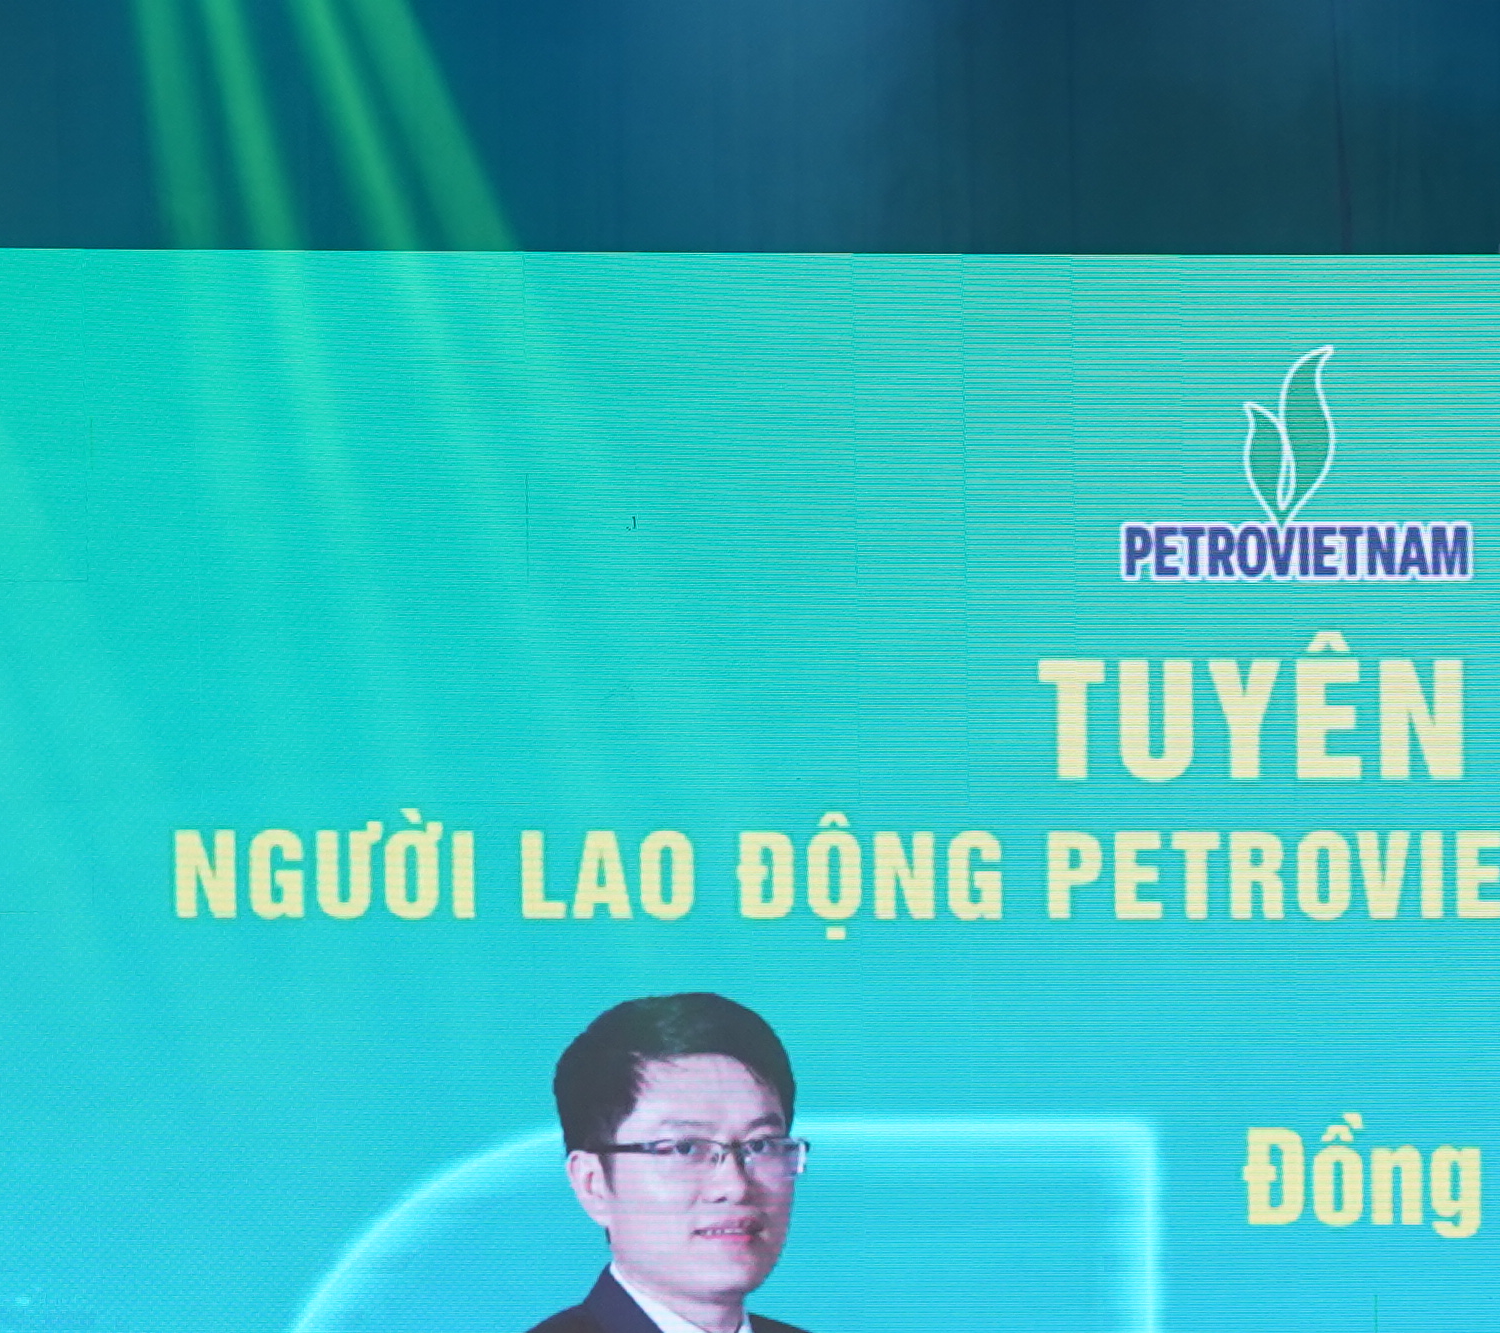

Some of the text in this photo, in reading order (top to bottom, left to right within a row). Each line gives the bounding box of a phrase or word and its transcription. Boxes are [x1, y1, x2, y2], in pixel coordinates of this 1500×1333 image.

[1122, 524, 1470, 578] PETROVIETNAM
[1037, 630, 1463, 781] TUYÊN
[175, 809, 474, 919] NGƯỜI
[521, 830, 693, 919] LAO
[737, 811, 1002, 941] ĐỘNG
[1243, 1111, 1481, 1238] Đồng
